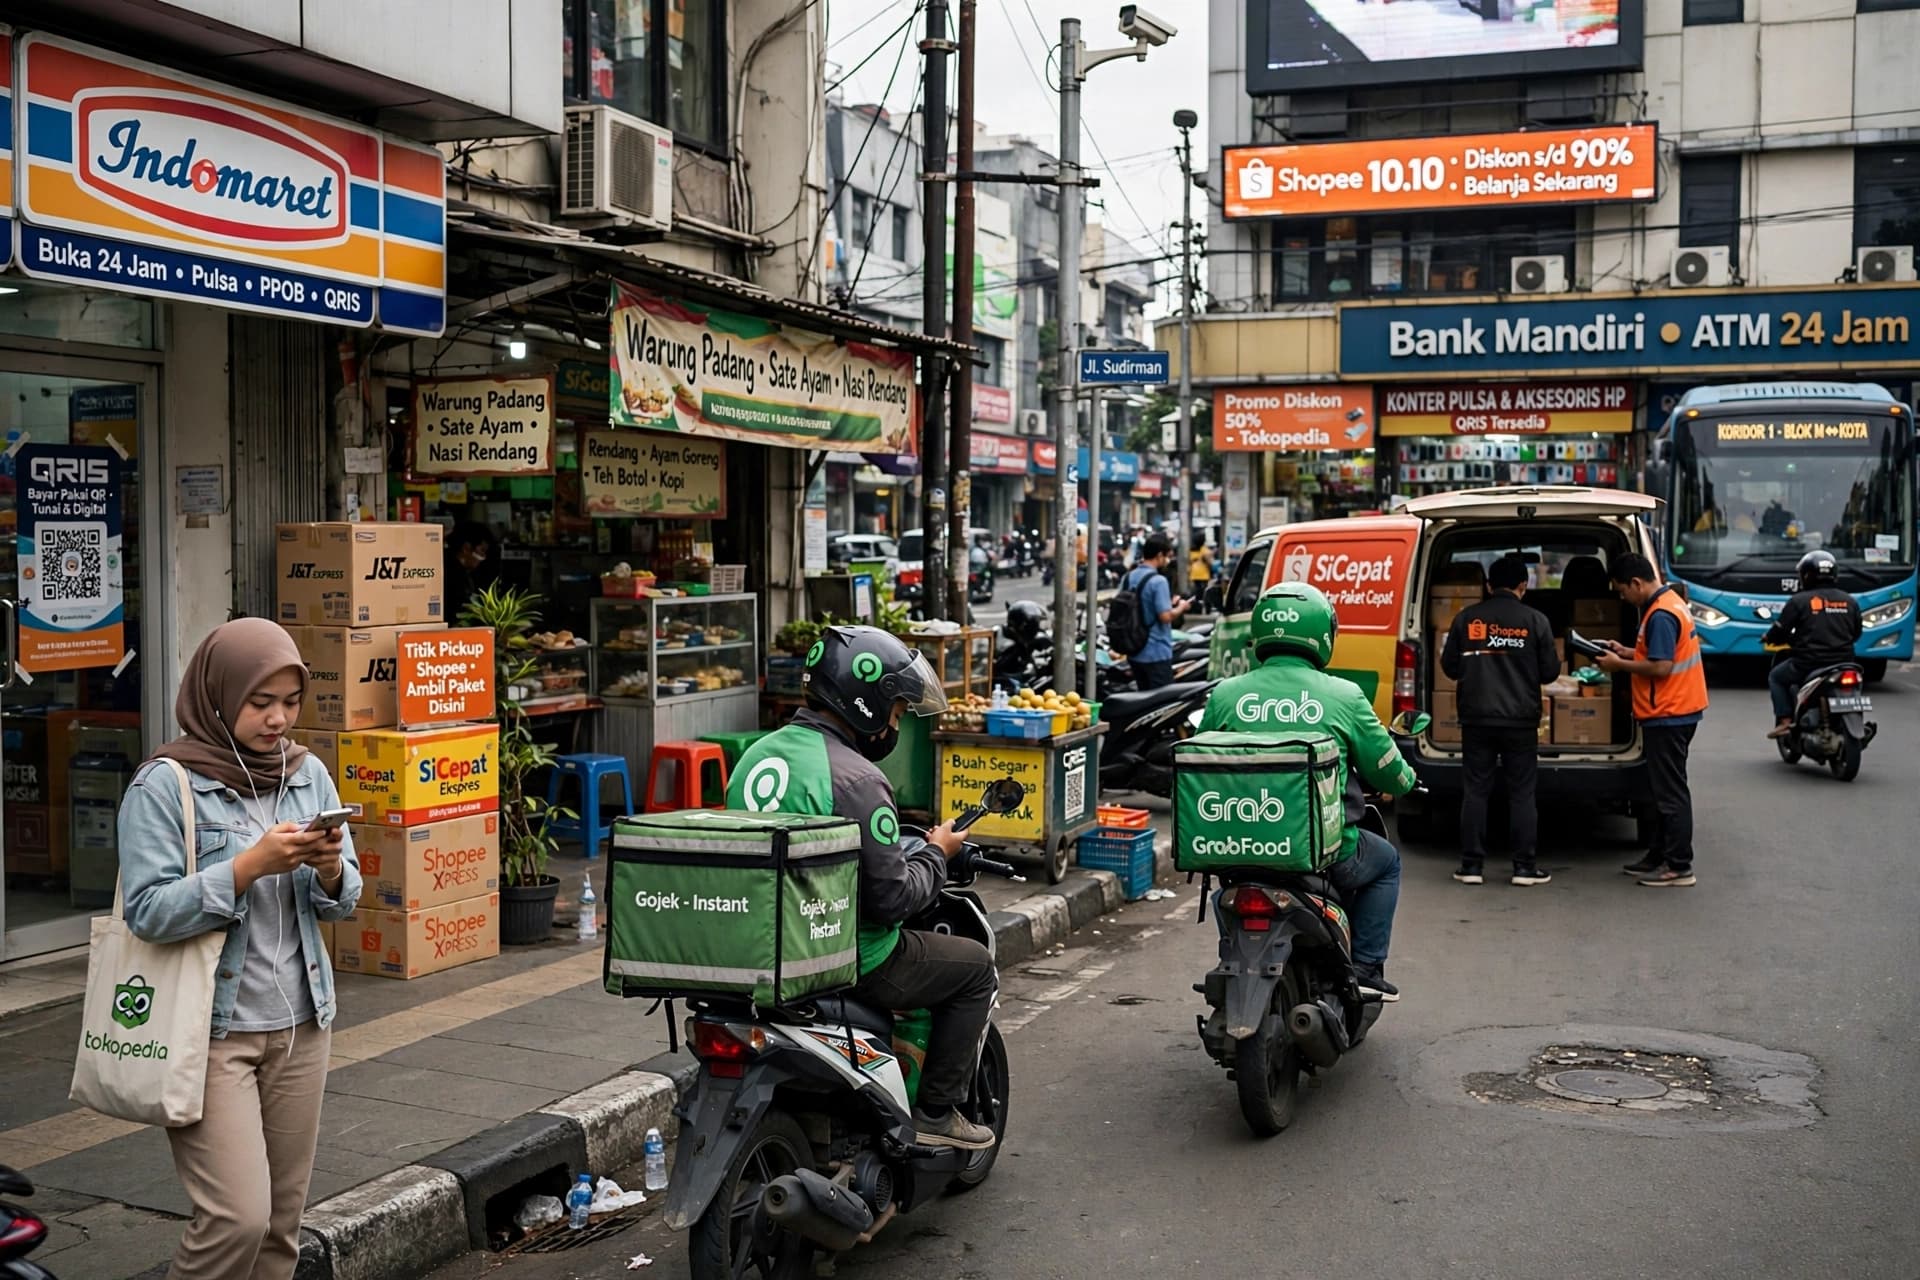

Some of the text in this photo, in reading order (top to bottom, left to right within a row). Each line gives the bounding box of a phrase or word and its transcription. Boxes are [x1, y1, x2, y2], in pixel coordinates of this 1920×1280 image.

[1465, 137, 1634, 170] Diskon s/d 90%
[98, 119, 332, 219] Indomaret
[1278, 167, 1363, 196] Shopee
[1368, 157, 1445, 193] 10.10
[1465, 171, 1617, 197] Belanja Sekarang
[39, 238, 360, 313] Buka 24 Jam Pulsa PPOB QRIS
[1389, 310, 1909, 357] Bank Mandiri ATM 24 Jam
[626, 315, 907, 414] Warung Padang Sate Ayam Nasi Rendang
[1084, 359, 1162, 375] Jl. Sudirman
[423, 389, 545, 416] Warung Padang
[1225, 392, 1342, 411] Promo Diskon
[1386, 387, 1626, 412] KONTER PULSA & AKSESORIS HP
[440, 417, 523, 437] Sate Ayam
[1225, 414, 1261, 428] 50%
[1455, 415, 1546, 432] QRIS Tersedia
[1718, 424, 1765, 440] KORIDOR
[1768, 424, 1775, 439] 1
[1784, 424, 1812, 439] BLOK
[1814, 424, 1824, 439] M
[1839, 423, 1868, 439] KOTA
[1240, 429, 1330, 447] Tokopedia
[429, 441, 537, 464] Nasi Rendang
[589, 439, 719, 470] Rendang Ayam Goreng
[31, 457, 108, 487] QRIS
[593, 467, 684, 492] Teh Botol Kopi
[28, 488, 106, 502] Bayar Pakai QR
[32, 503, 106, 517] Tunai & Digital
[287, 563, 344, 579] J&T EXPRESS
[365, 557, 435, 580] J&T EXPRESS
[1314, 554, 1393, 588] SiCepat
[1366, 590, 1395, 608] Cepat
[1262, 608, 1299, 623] Grab
[404, 640, 484, 658] Titik Pickup
[1488, 635, 1525, 648] Xpress
[416, 661, 467, 678] Shopee
[406, 679, 485, 697] Ambil Paket
[429, 697, 465, 714] Disini
[1236, 690, 1324, 725] Grab
[345, 764, 395, 784] SiCepat
[419, 754, 487, 784] SiCepat
[952, 754, 1029, 775] Buah Segar
[440, 780, 481, 796] Ekspres
[1198, 788, 1284, 823] Grab
[1192, 835, 1291, 856] GrabFood
[423, 846, 486, 871] Shopee
[433, 868, 479, 891] XPRESS
[635, 891, 679, 913] Gojek
[693, 894, 749, 913] Instant
[425, 912, 486, 941] Shopee
[434, 934, 478, 959] XPRESS
[85, 1030, 168, 1061] tokopedia
